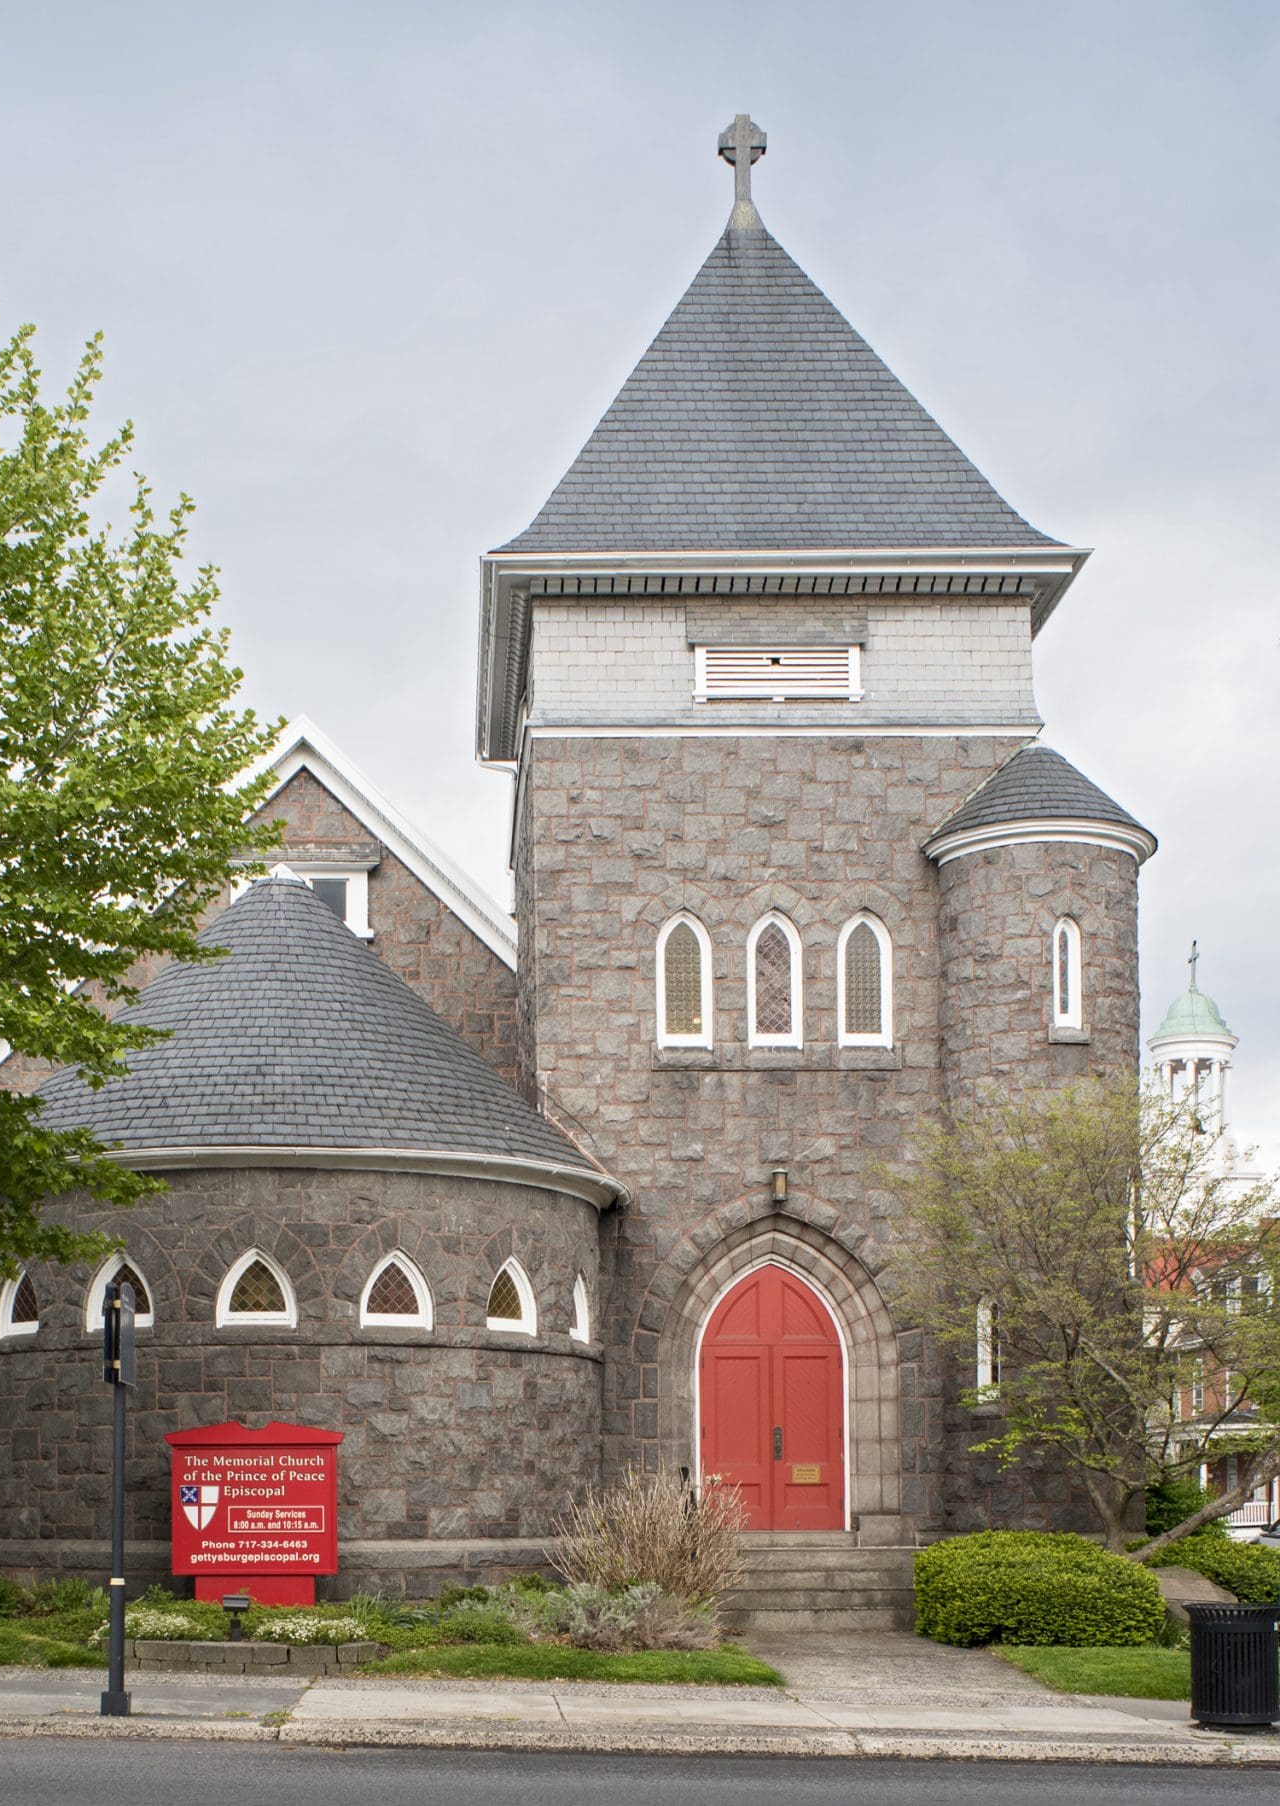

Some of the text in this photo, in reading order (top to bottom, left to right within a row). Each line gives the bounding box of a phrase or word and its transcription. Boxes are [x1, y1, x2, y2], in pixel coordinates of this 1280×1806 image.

[184, 1456, 324, 1466] The Memorial Church
[184, 1470, 325, 1480] of the Prince of Peace
[224, 1486, 285, 1498] Episcopal
[246, 1510, 306, 1520] Sunday Services
[234, 1520, 249, 1529] 8:00
[268, 1520, 280, 1529] and
[283, 1520, 302, 1529] 10:15
[202, 1540, 235, 1548] Phone
[190, 1552, 320, 1564] gettysburgepiscopal.org
